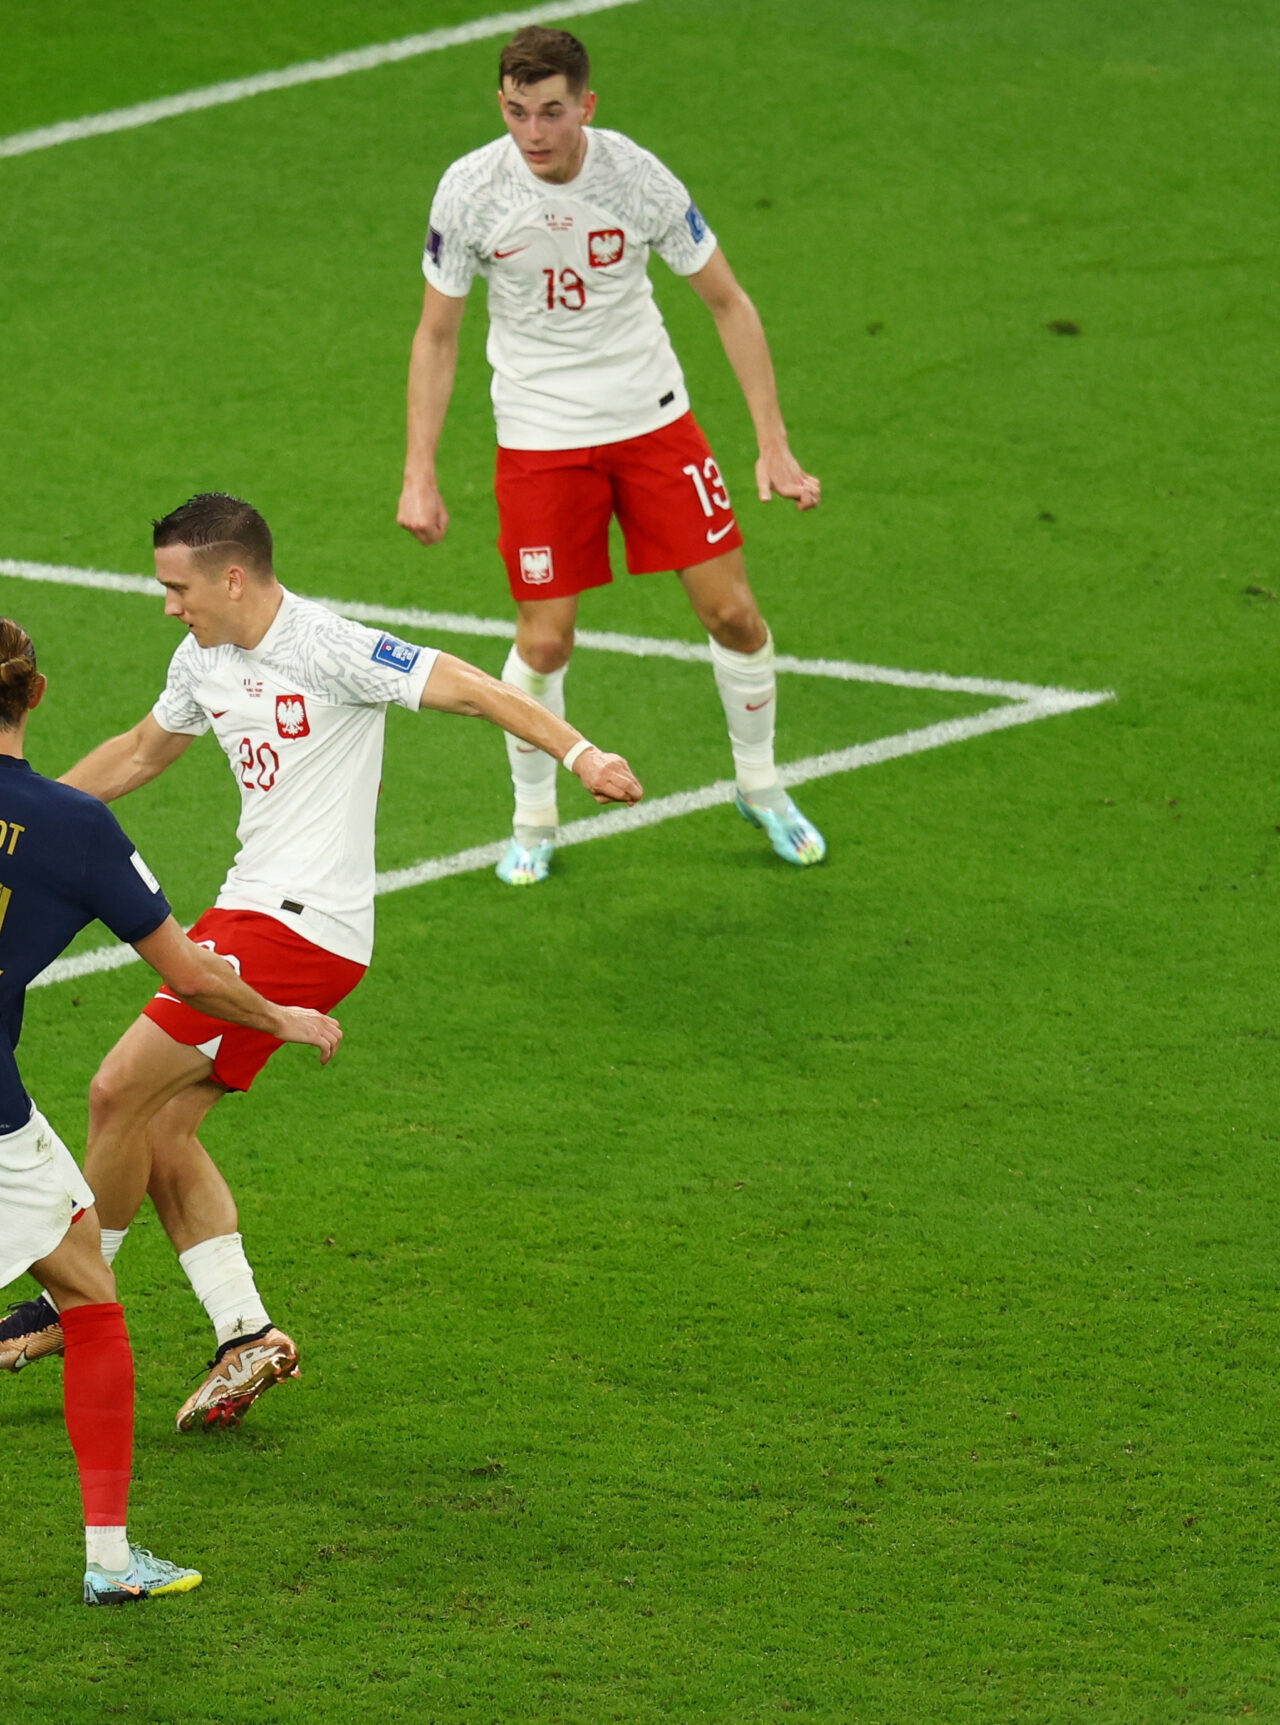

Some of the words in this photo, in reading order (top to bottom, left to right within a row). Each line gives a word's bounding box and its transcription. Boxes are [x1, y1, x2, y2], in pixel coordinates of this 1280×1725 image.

[542, 268, 586, 311] 13
[682, 456, 732, 518] 13
[239, 738, 280, 792] 20
